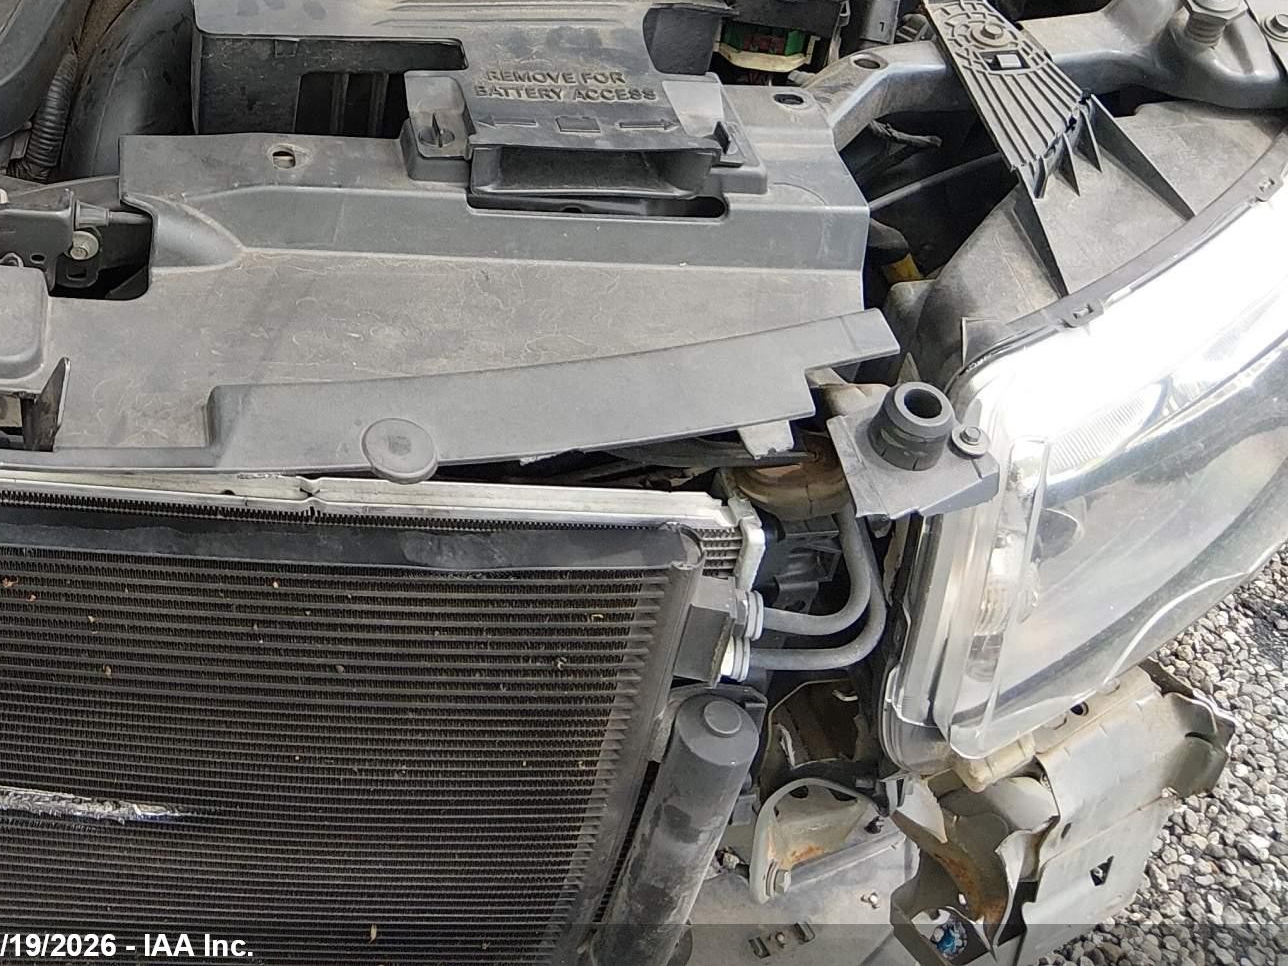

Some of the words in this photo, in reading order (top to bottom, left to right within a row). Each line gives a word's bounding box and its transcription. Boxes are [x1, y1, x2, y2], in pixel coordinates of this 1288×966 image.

[486, 70, 577, 84] REMOVE
[580, 71, 626, 85] FOR
[474, 84, 563, 101] BATTERY
[572, 87, 657, 102] ACCESS
